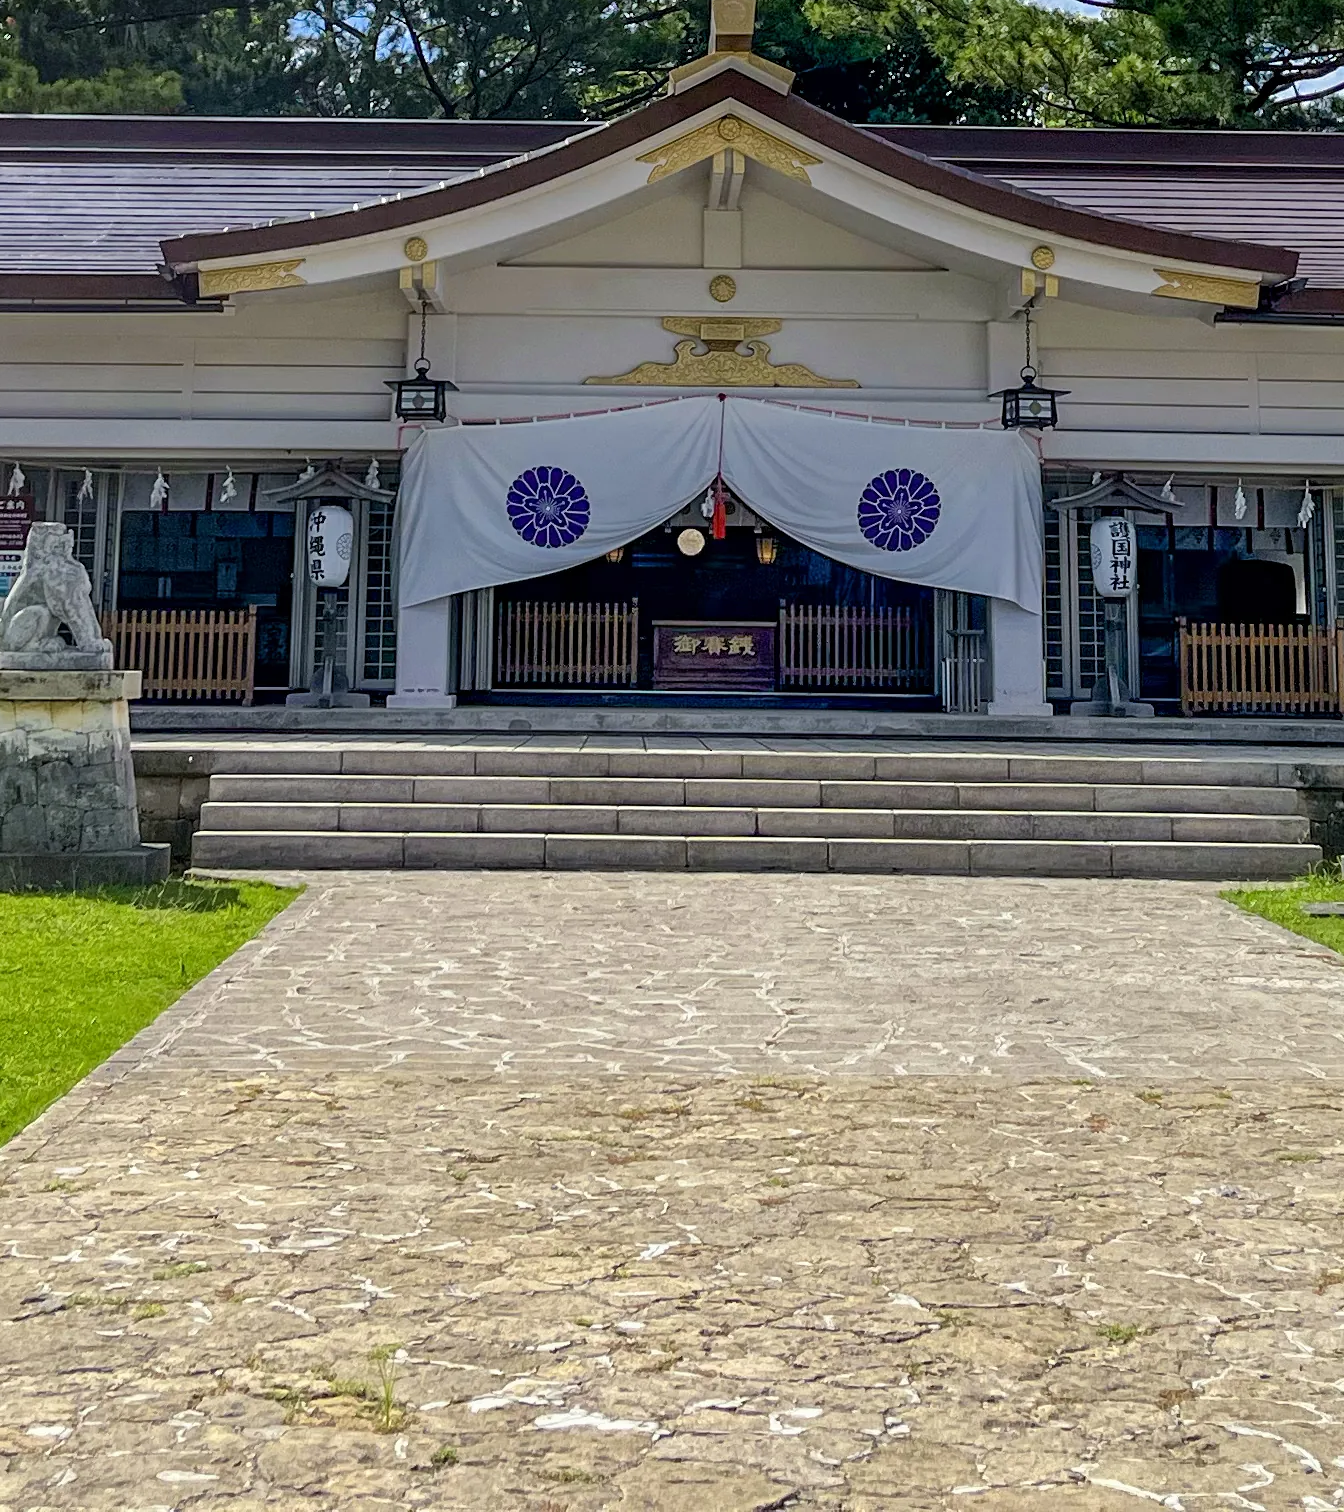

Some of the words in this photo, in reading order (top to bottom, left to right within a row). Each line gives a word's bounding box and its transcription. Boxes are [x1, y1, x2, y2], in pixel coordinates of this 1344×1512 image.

[309, 511, 327, 581] 沖縄県
[1108, 521, 1132, 591] 護国神社
